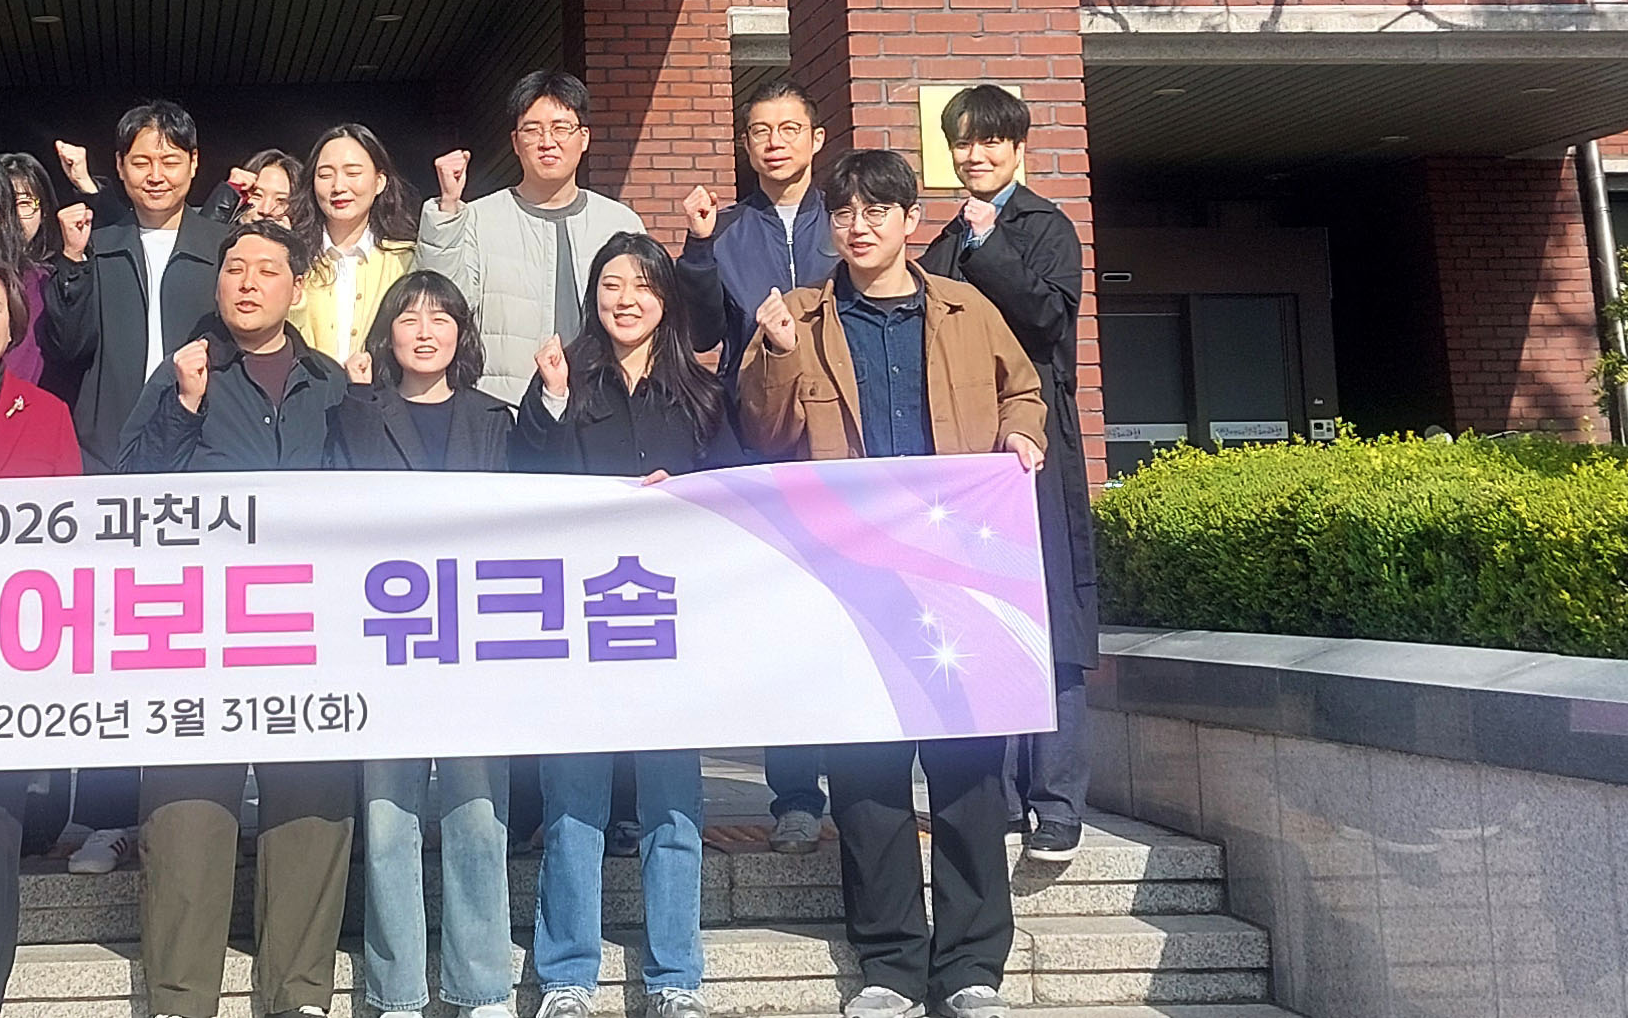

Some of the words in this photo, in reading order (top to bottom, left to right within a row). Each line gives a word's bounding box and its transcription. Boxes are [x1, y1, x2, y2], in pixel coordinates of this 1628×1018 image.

[94, 493, 258, 548] 과천시
[362, 554, 678, 667] 워크숍
[145, 695, 207, 738] 3월
[220, 690, 370, 735] 31일(화)
